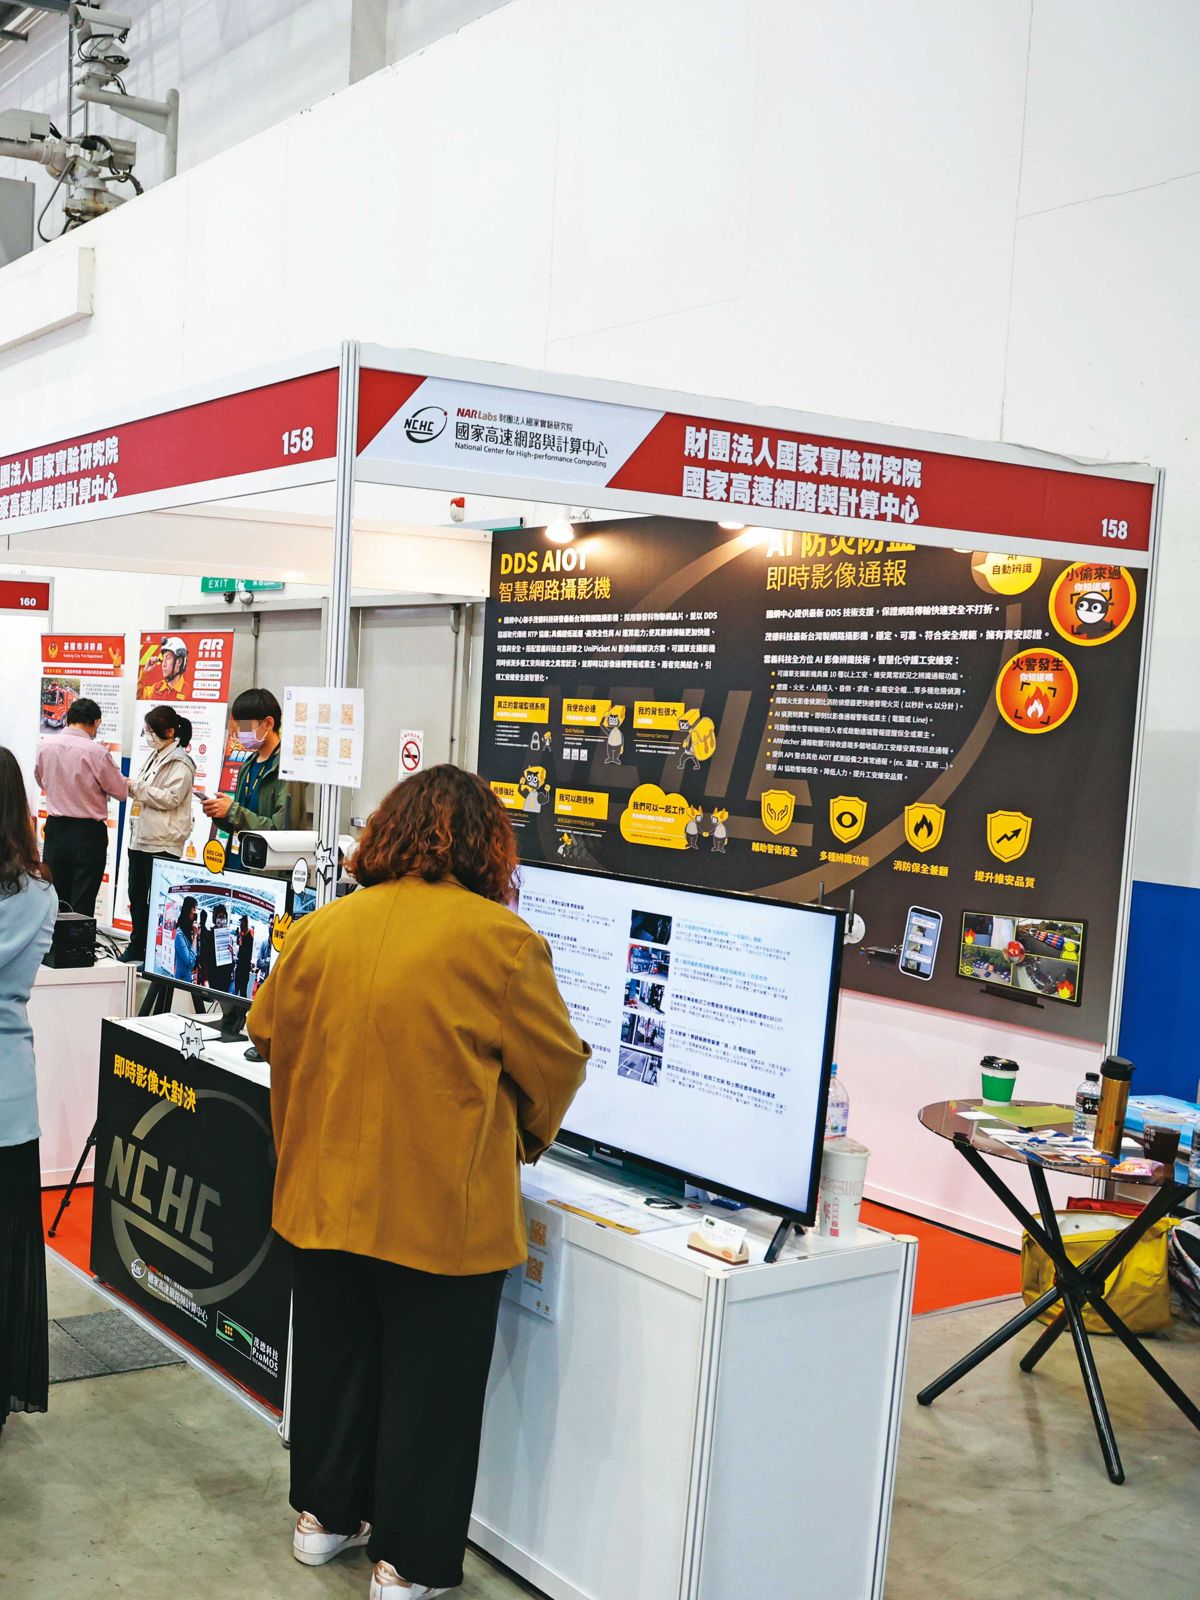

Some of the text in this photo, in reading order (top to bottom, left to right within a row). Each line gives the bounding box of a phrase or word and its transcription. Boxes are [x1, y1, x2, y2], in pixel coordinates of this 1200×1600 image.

[404, 418, 434, 432] NCHC
[282, 427, 313, 455] 158
[456, 422, 608, 458] 國家高速網路與計算中心
[455, 442, 607, 468] National Center for High-performance Computing
[684, 426, 922, 488] 財團法人國家實驗研究院
[682, 465, 919, 524] 國家高速網路與計算中心
[1102, 519, 1128, 539] 158
[500, 548, 587, 574] DDS AIOT
[992, 563, 1032, 575] 自動辨識
[766, 559, 906, 591] 即時影像通報
[208, 580, 228, 588] EXIT
[499, 576, 611, 602] 智慧網路攝影機
[20, 597, 37, 606] 160
[703, 611, 718, 620] DDS
[825, 608, 841, 618] DDS
[199, 639, 224, 650] AR
[815, 656, 823, 664] AI
[1012, 658, 1063, 672] 火警發生
[566, 704, 596, 713] 我使命必達
[638, 707, 677, 716] 我的背包很大
[633, 802, 685, 815] 我們可以一起工作
[819, 850, 870, 867] 多種辨識功能
[893, 860, 949, 877] 消防保全兼顧
[974, 870, 1035, 888] 提升維安品質
[114, 1055, 196, 1113] 即時影像大對決
[105, 1135, 221, 1252] NCHC
[253, 1336, 279, 1362] 茂德科技
[252, 1346, 279, 1372] ProMOS
